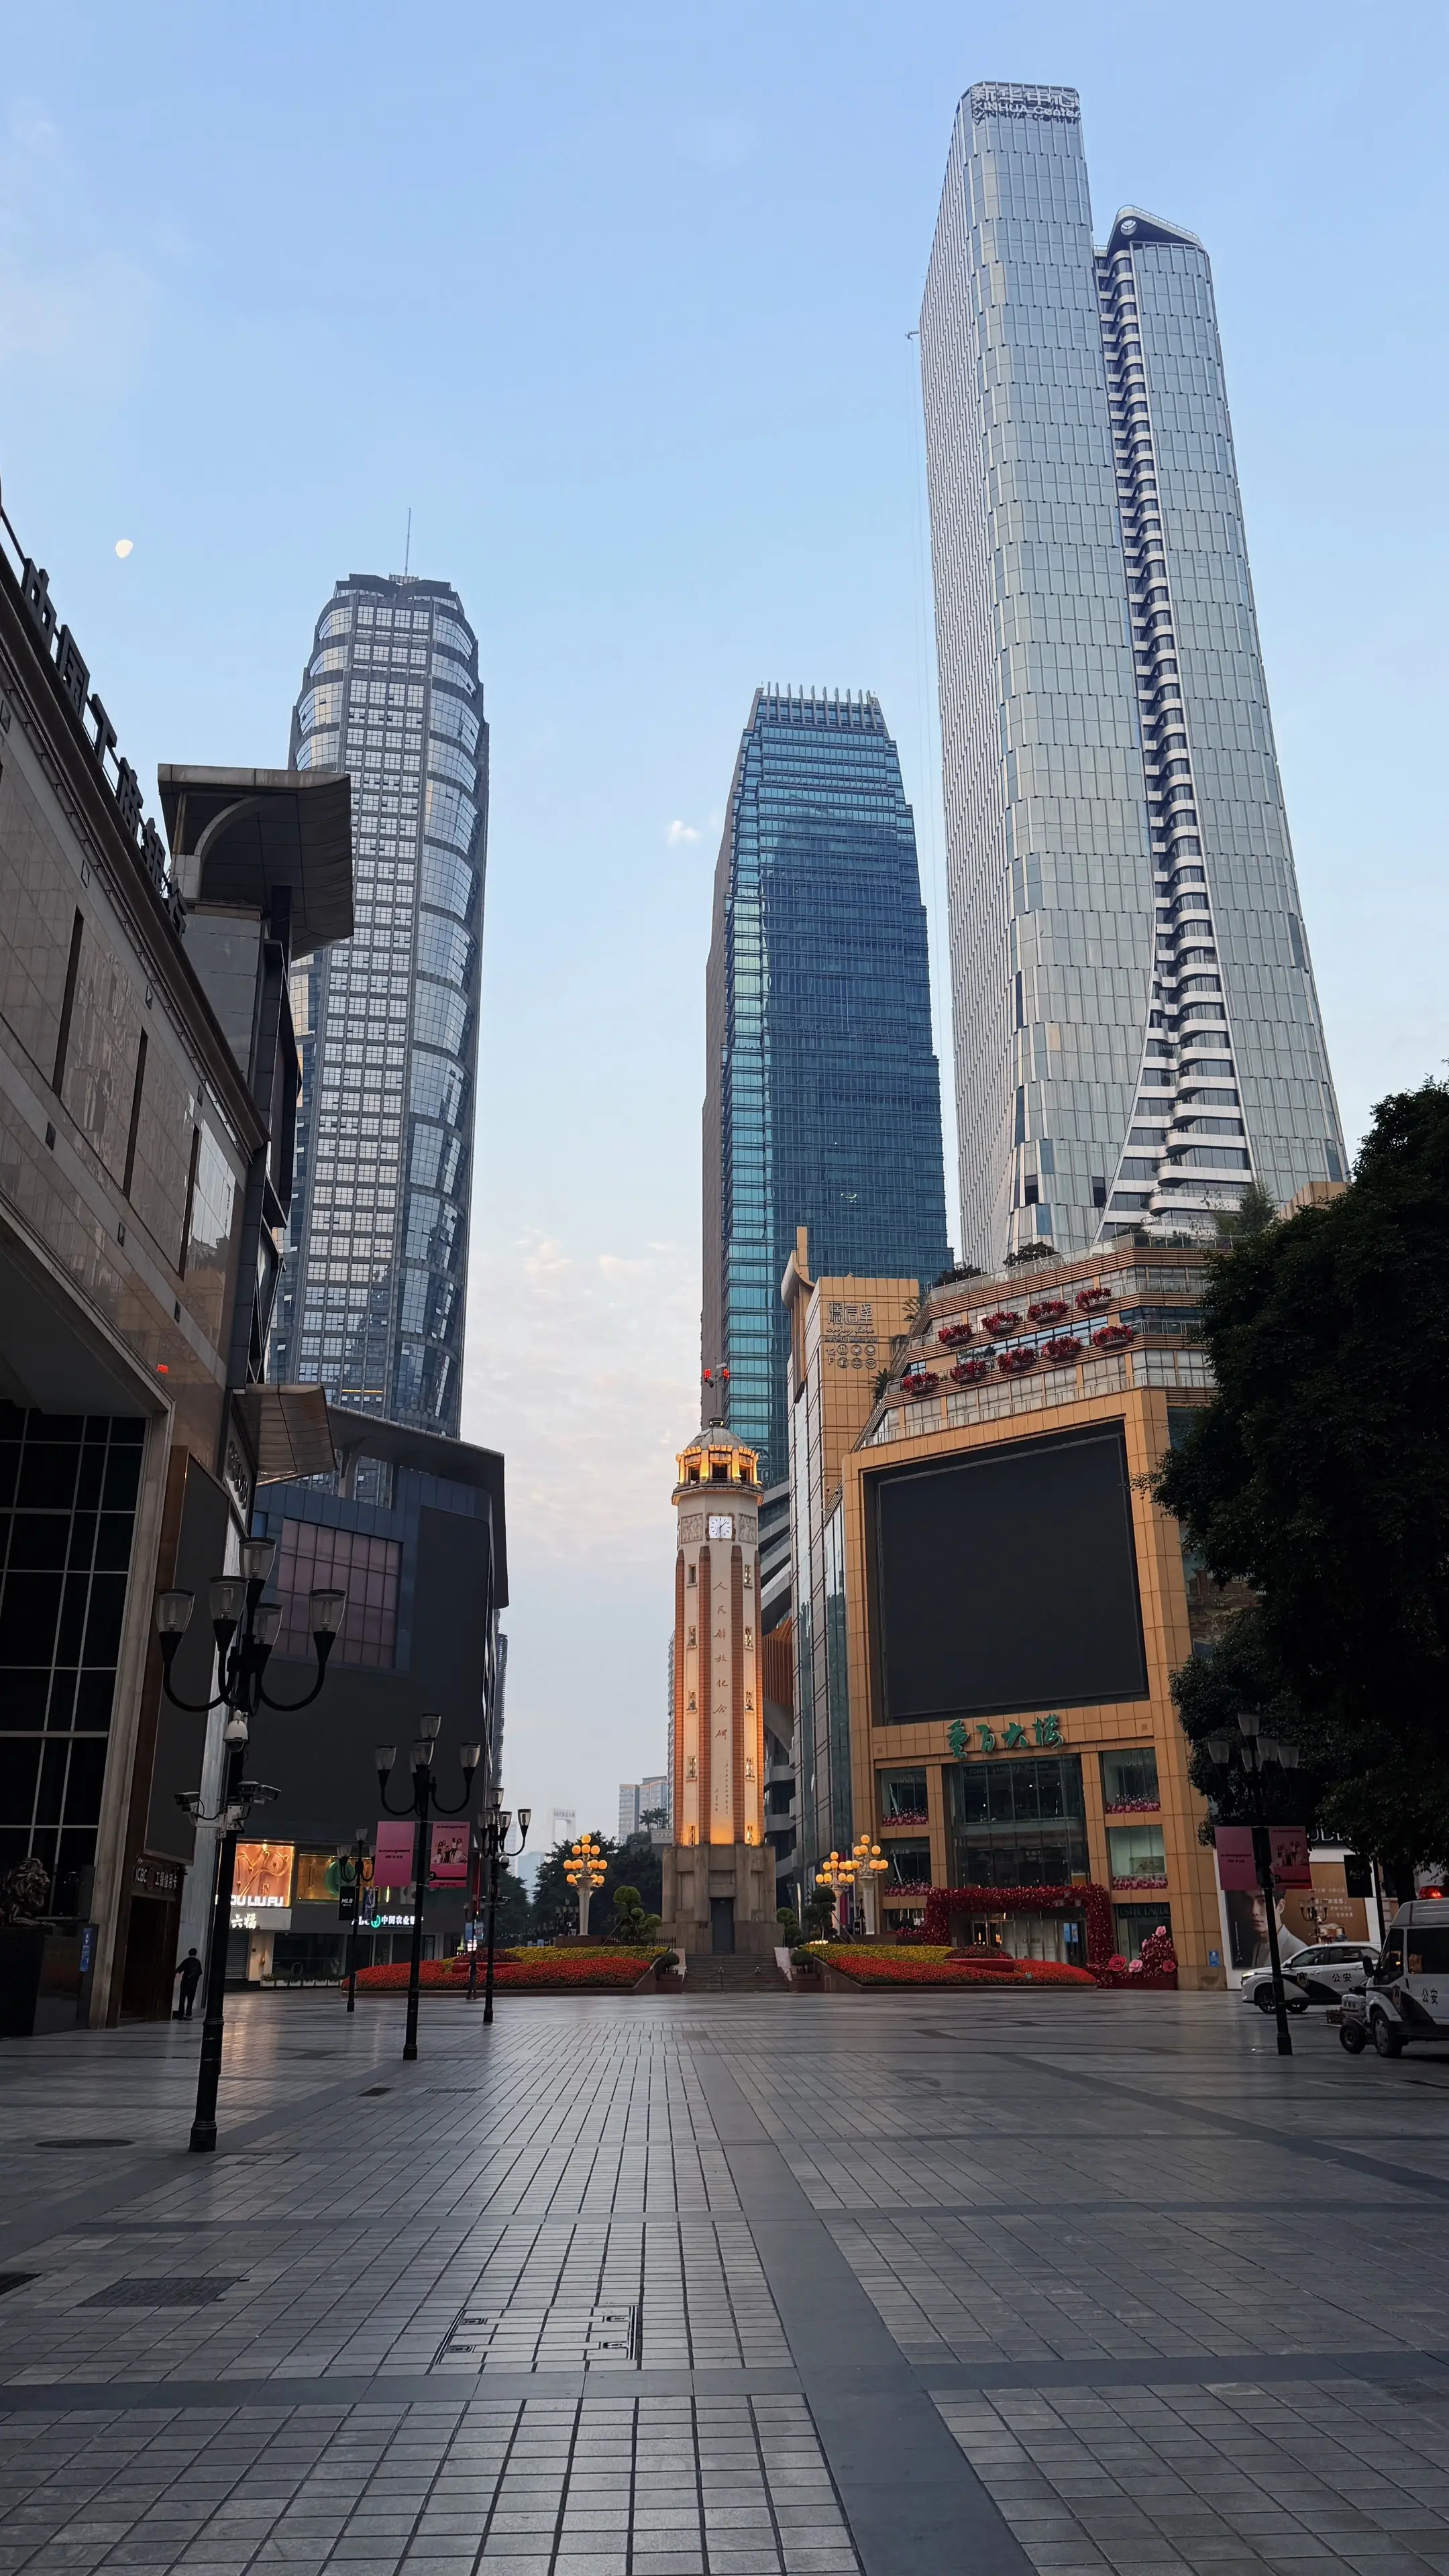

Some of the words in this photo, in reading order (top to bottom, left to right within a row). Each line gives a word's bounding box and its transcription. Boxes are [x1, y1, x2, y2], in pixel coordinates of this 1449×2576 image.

[971, 85, 1080, 108] 新华中心
[972, 100, 1028, 113] XINHUA
[1033, 106, 1081, 118] Center
[1332, 1973, 1352, 1982] 公安
[1421, 1988, 1438, 2004] 公安
